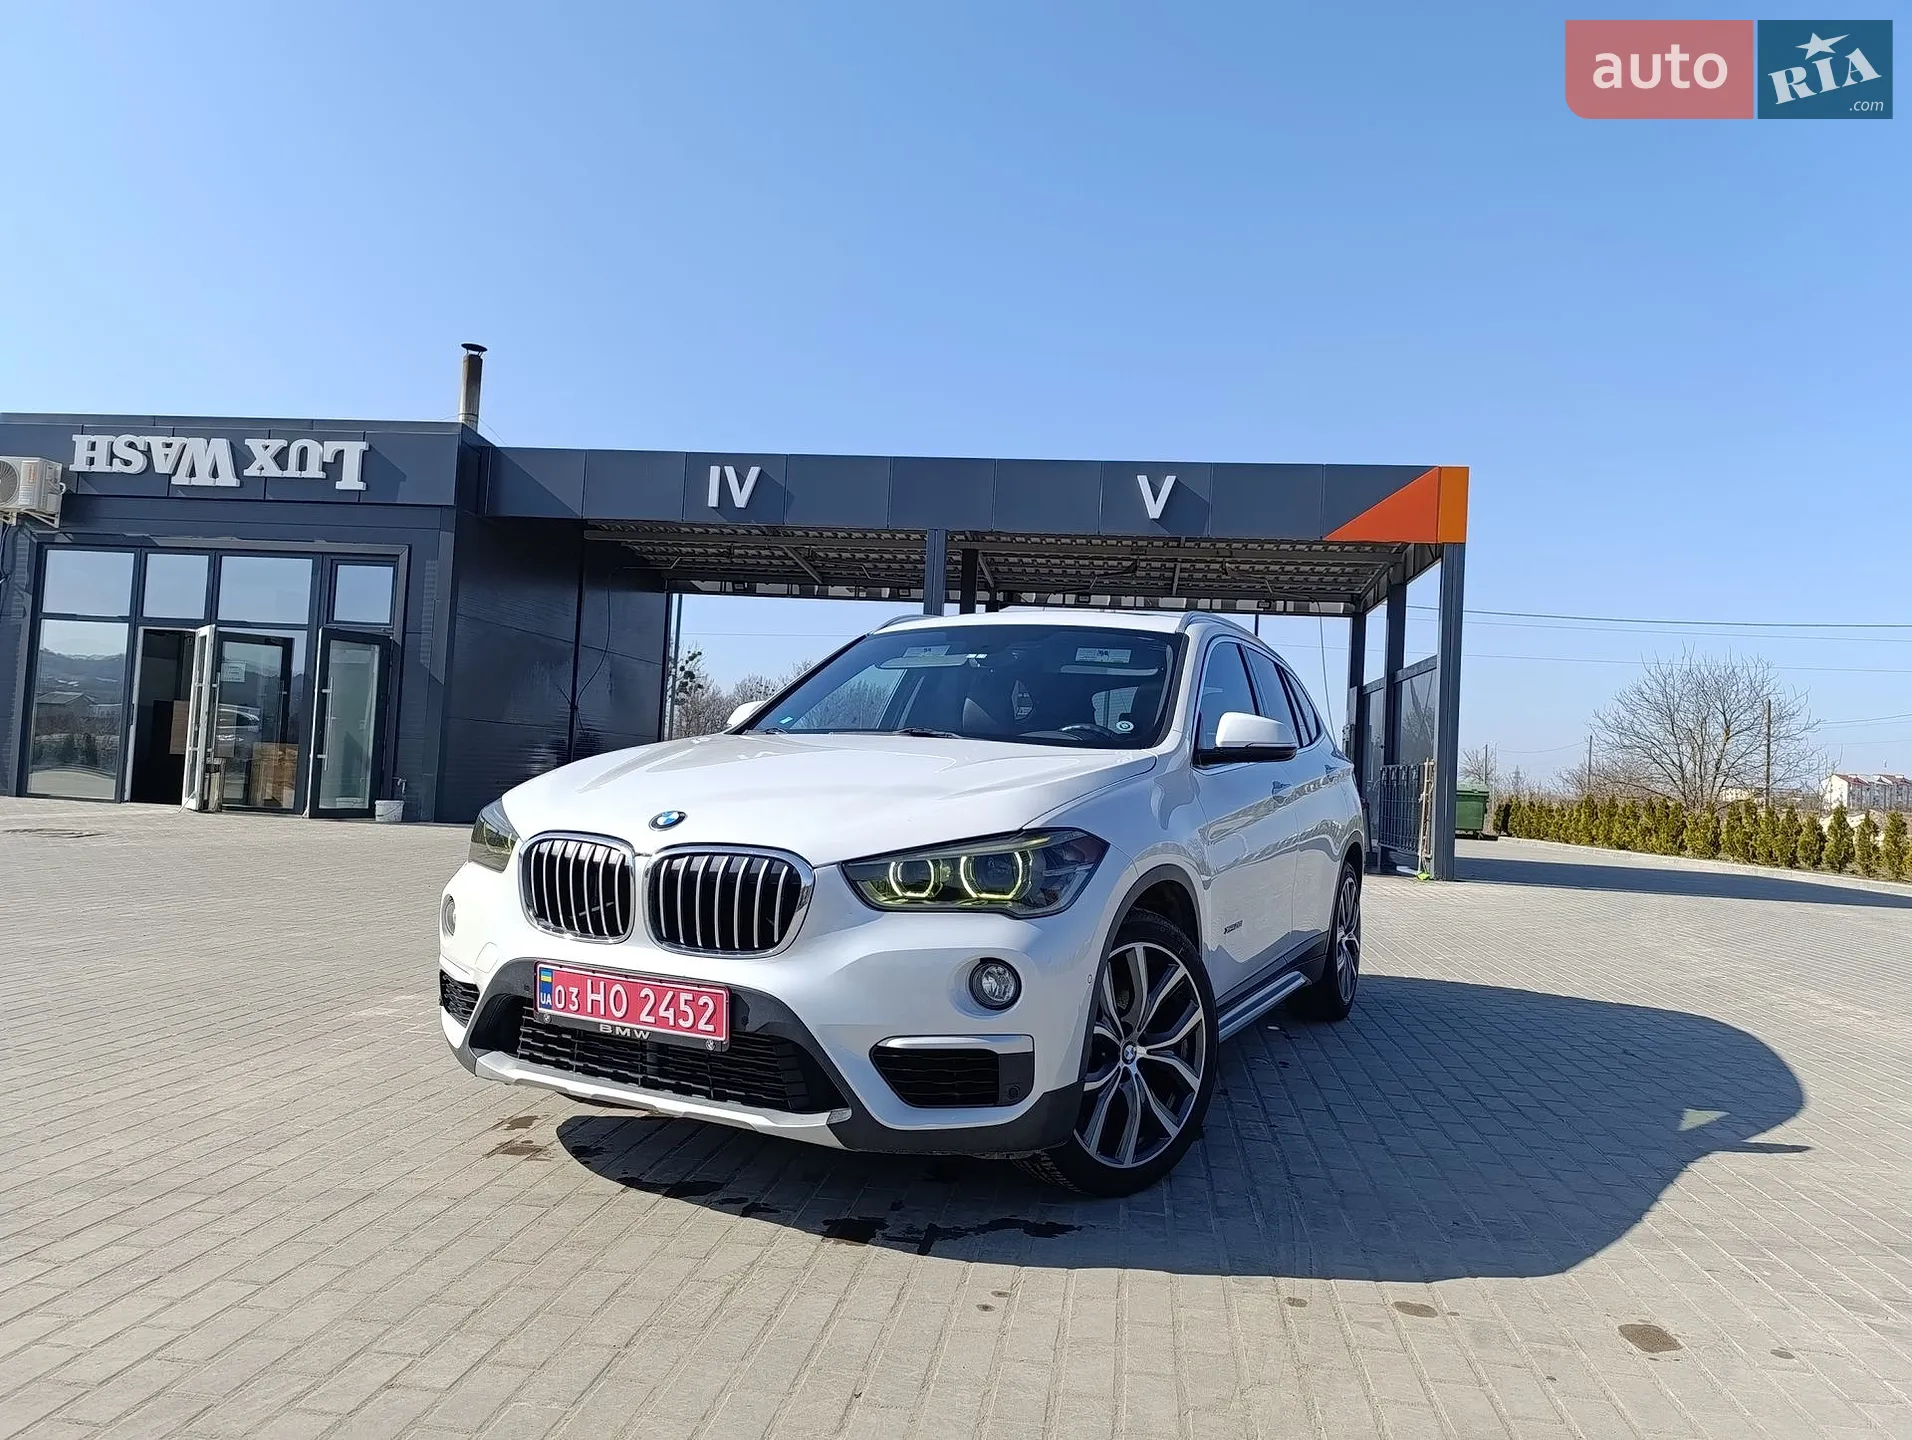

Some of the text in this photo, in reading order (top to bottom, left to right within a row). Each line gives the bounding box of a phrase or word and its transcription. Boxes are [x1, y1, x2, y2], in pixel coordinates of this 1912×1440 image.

[69, 434, 369, 490] LUX WASH
[707, 465, 761, 508] IV
[1136, 475, 1177, 519] V
[540, 992, 552, 1006] UA
[554, 979, 716, 1032] 03 HO 2452
[599, 1023, 651, 1040] BMW
